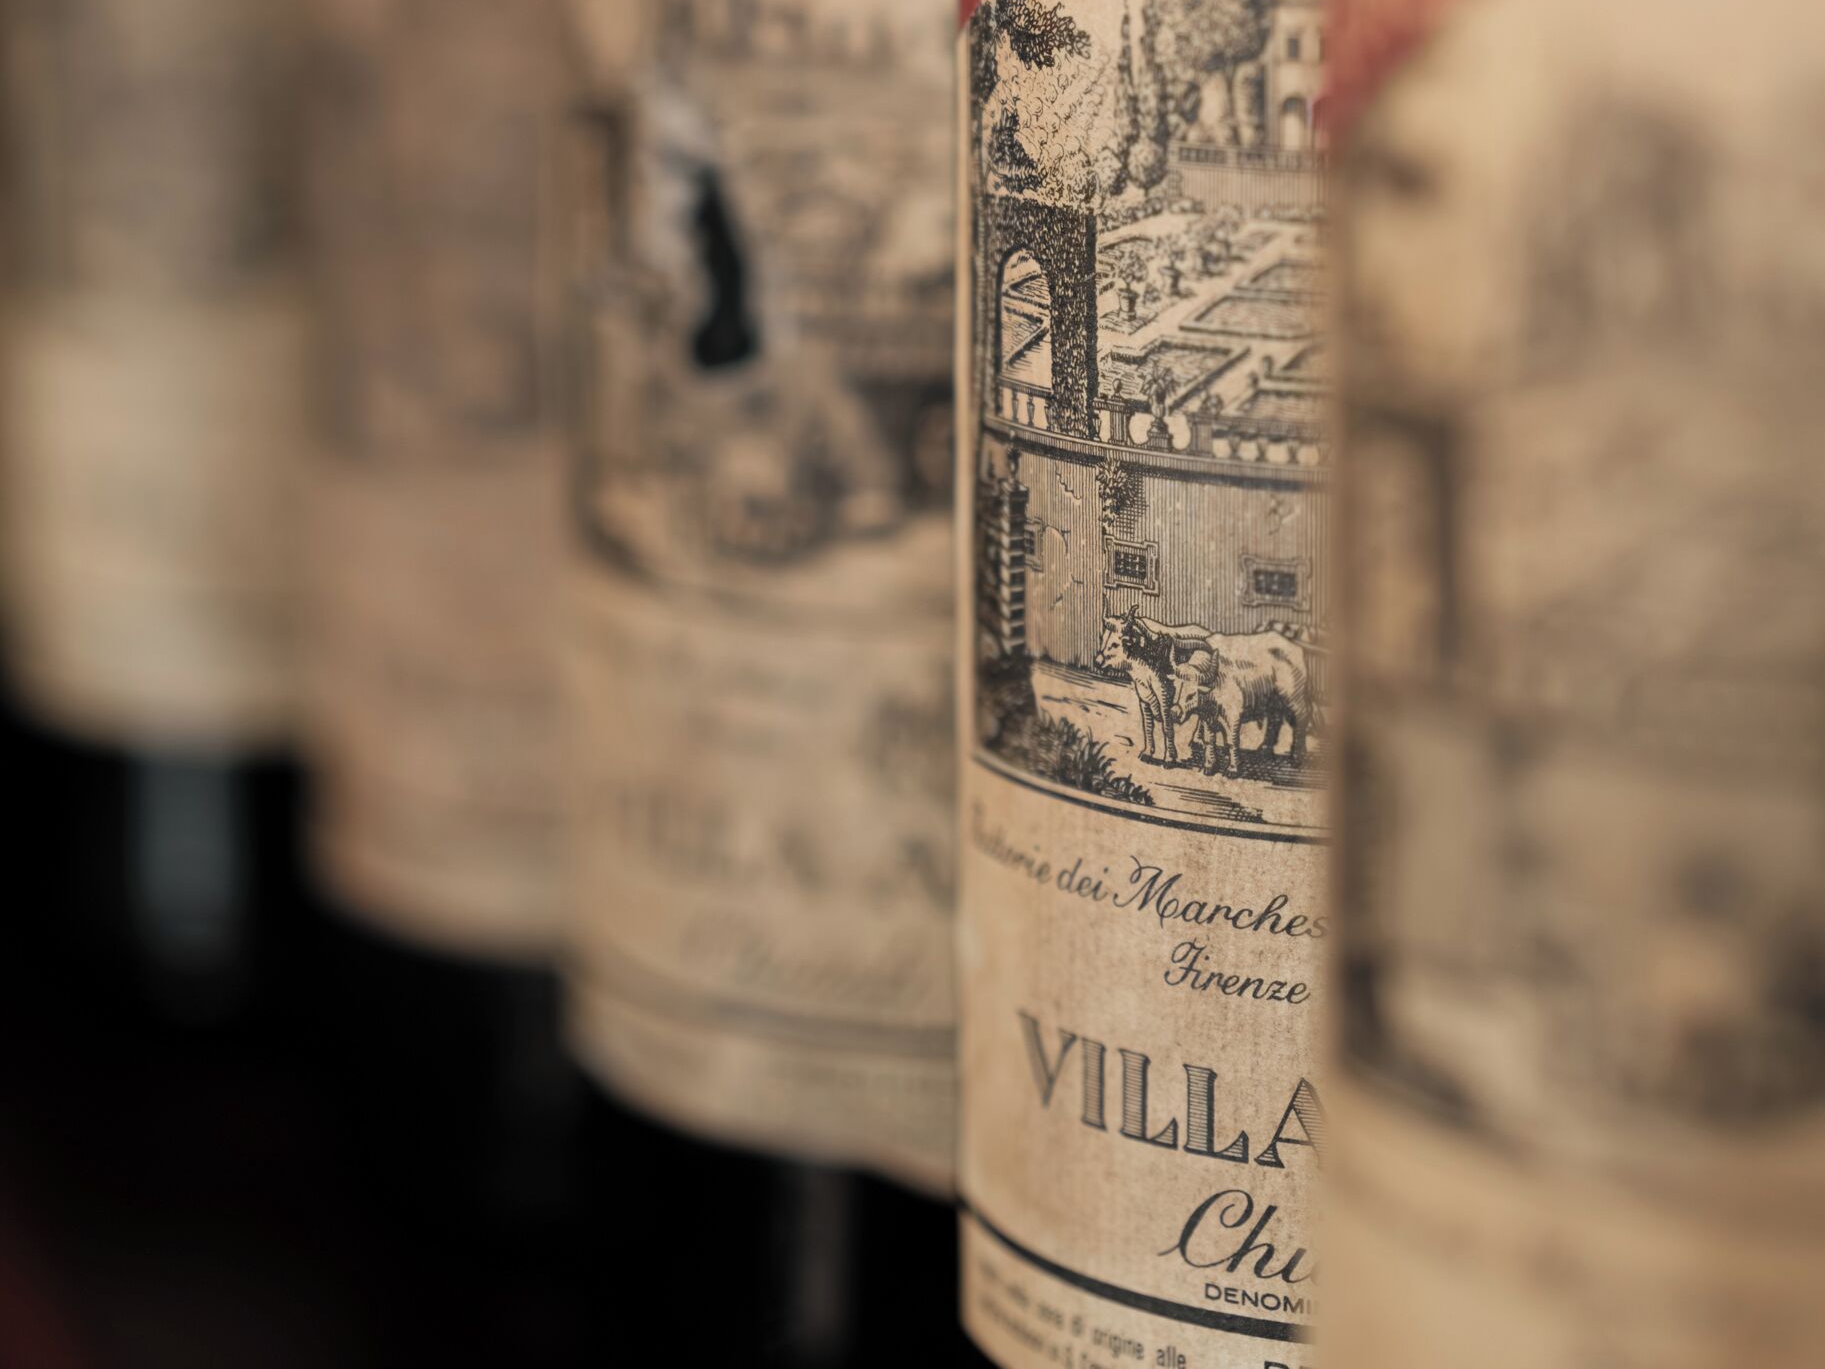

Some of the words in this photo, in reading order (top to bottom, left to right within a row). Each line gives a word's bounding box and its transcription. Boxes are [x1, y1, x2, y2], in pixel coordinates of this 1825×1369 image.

[1057, 857, 1109, 901] dei
[1164, 937, 1311, 1005] Firenze
[1017, 1008, 1326, 1170] VILLA
[1204, 1283, 1318, 1315] DENOMI
